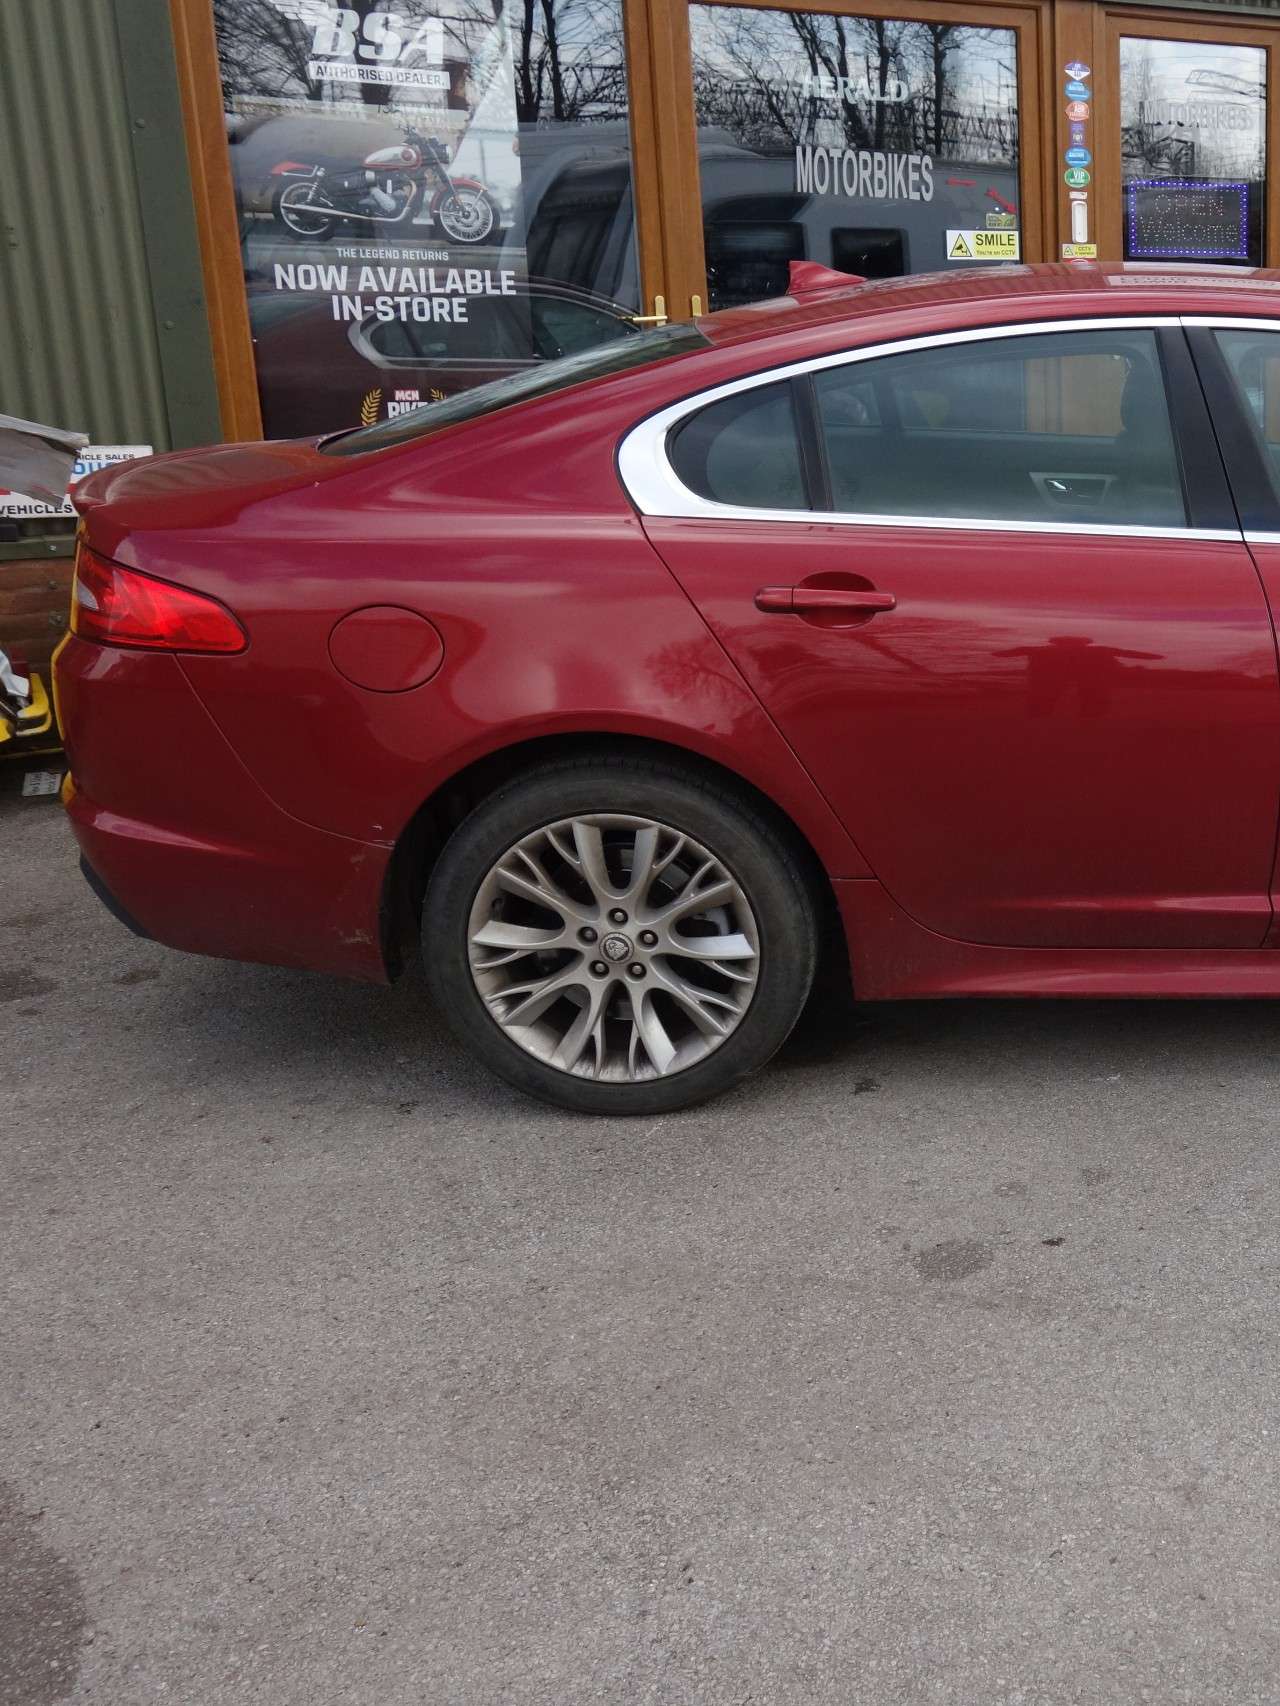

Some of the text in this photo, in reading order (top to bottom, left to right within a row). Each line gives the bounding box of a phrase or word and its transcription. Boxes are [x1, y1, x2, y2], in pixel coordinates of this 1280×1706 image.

[311, 8, 444, 65] BSA
[315, 66, 394, 82] AUTHORISED
[801, 74, 910, 105] HERALD
[795, 145, 934, 202] MOTORBIKES
[1154, 193, 1224, 216] OPEN
[975, 233, 1016, 246] SMILE
[335, 247, 449, 261] THE LEGEND RETURNS
[273, 263, 517, 296] NOW AVAILABLE
[331, 294, 469, 323] IN-STORE
[395, 389, 420, 401] MCN
[0, 504, 74, 515] VEHICLES
